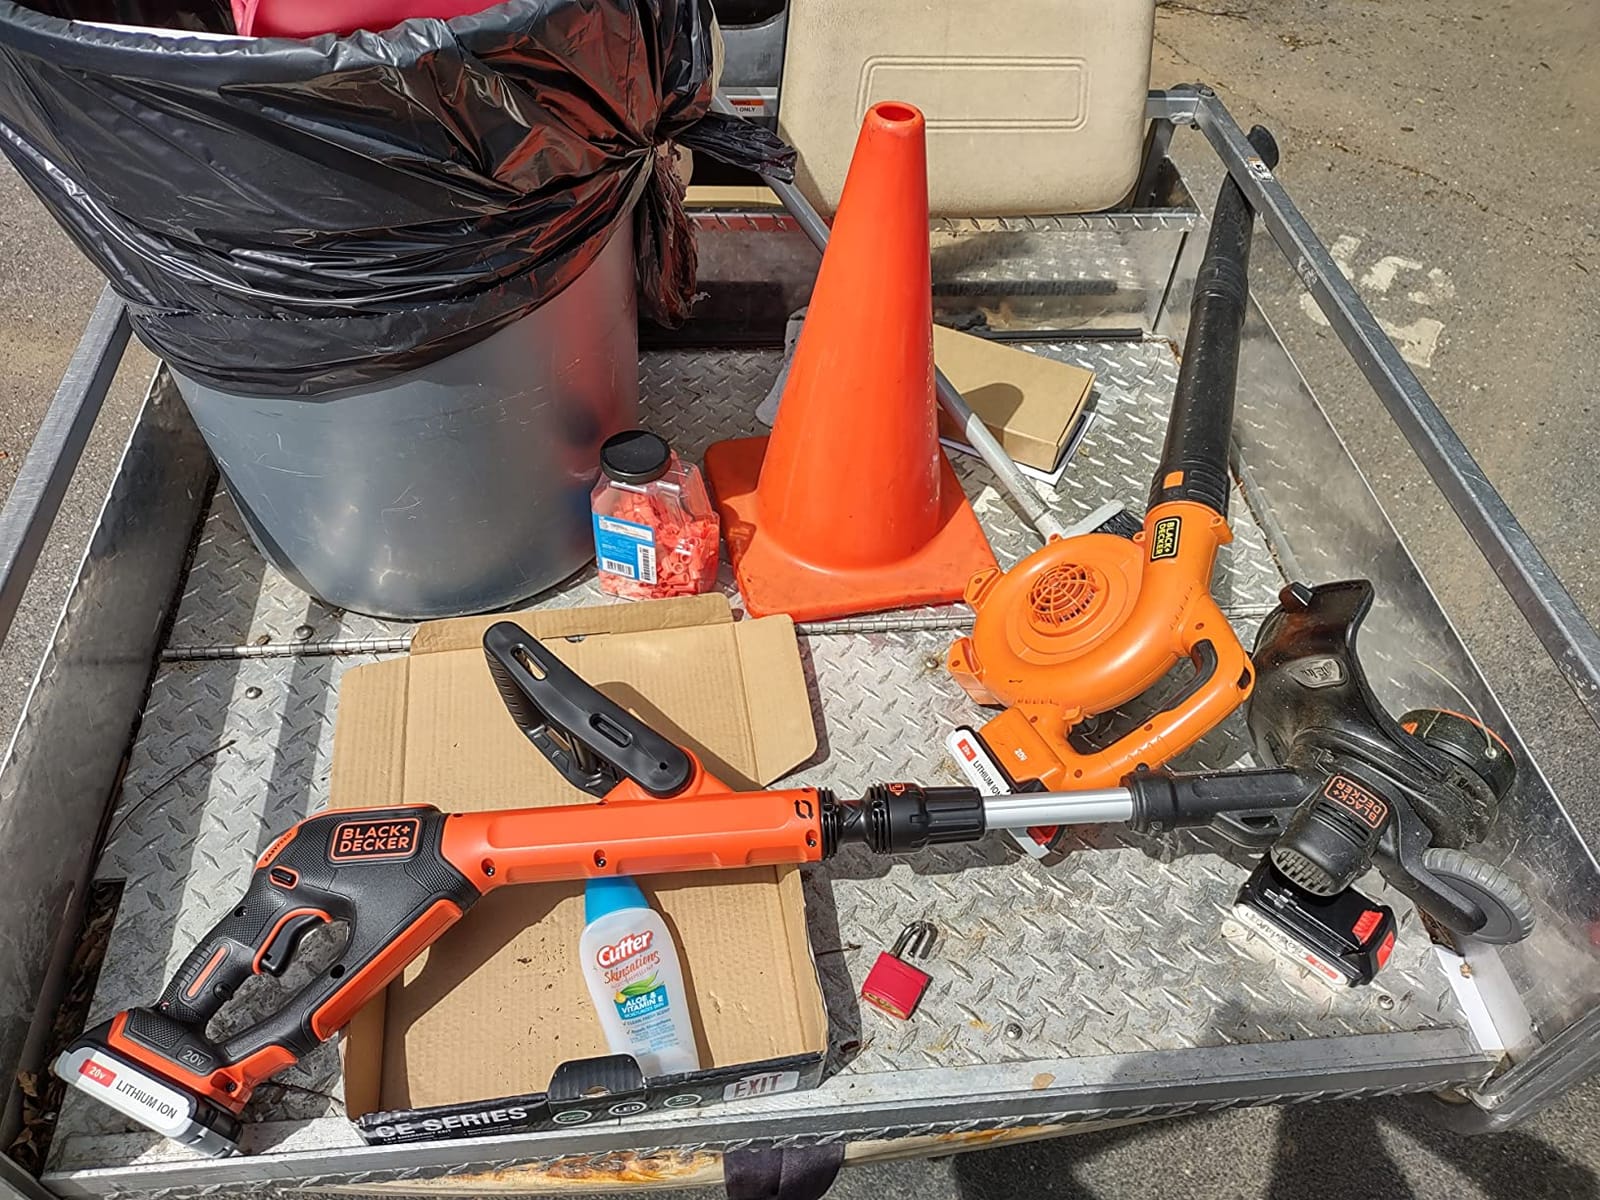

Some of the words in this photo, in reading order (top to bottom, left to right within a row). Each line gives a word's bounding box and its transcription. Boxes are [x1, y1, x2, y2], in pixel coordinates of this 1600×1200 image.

[1156, 523, 1166, 555] DECKER
[1164, 522, 1175, 552] BLACK+
[973, 760, 994, 787] LITHIUM
[1333, 789, 1377, 822] BLACK+
[1336, 780, 1382, 814] DECKER
[339, 837, 410, 852] DECKER
[342, 825, 411, 839] BLACK+
[597, 931, 653, 967] Cutter
[604, 950, 660, 984] Skinsations
[621, 998, 656, 1014] VITAMIN
[625, 995, 648, 1007] ALOE
[649, 991, 657, 999] &
[734, 1074, 782, 1098] EXIT
[116, 1080, 158, 1109] LITHIUM
[156, 1102, 178, 1120] ION
[615, 1104, 640, 1115] LED
[421, 1107, 528, 1132] SERIES
